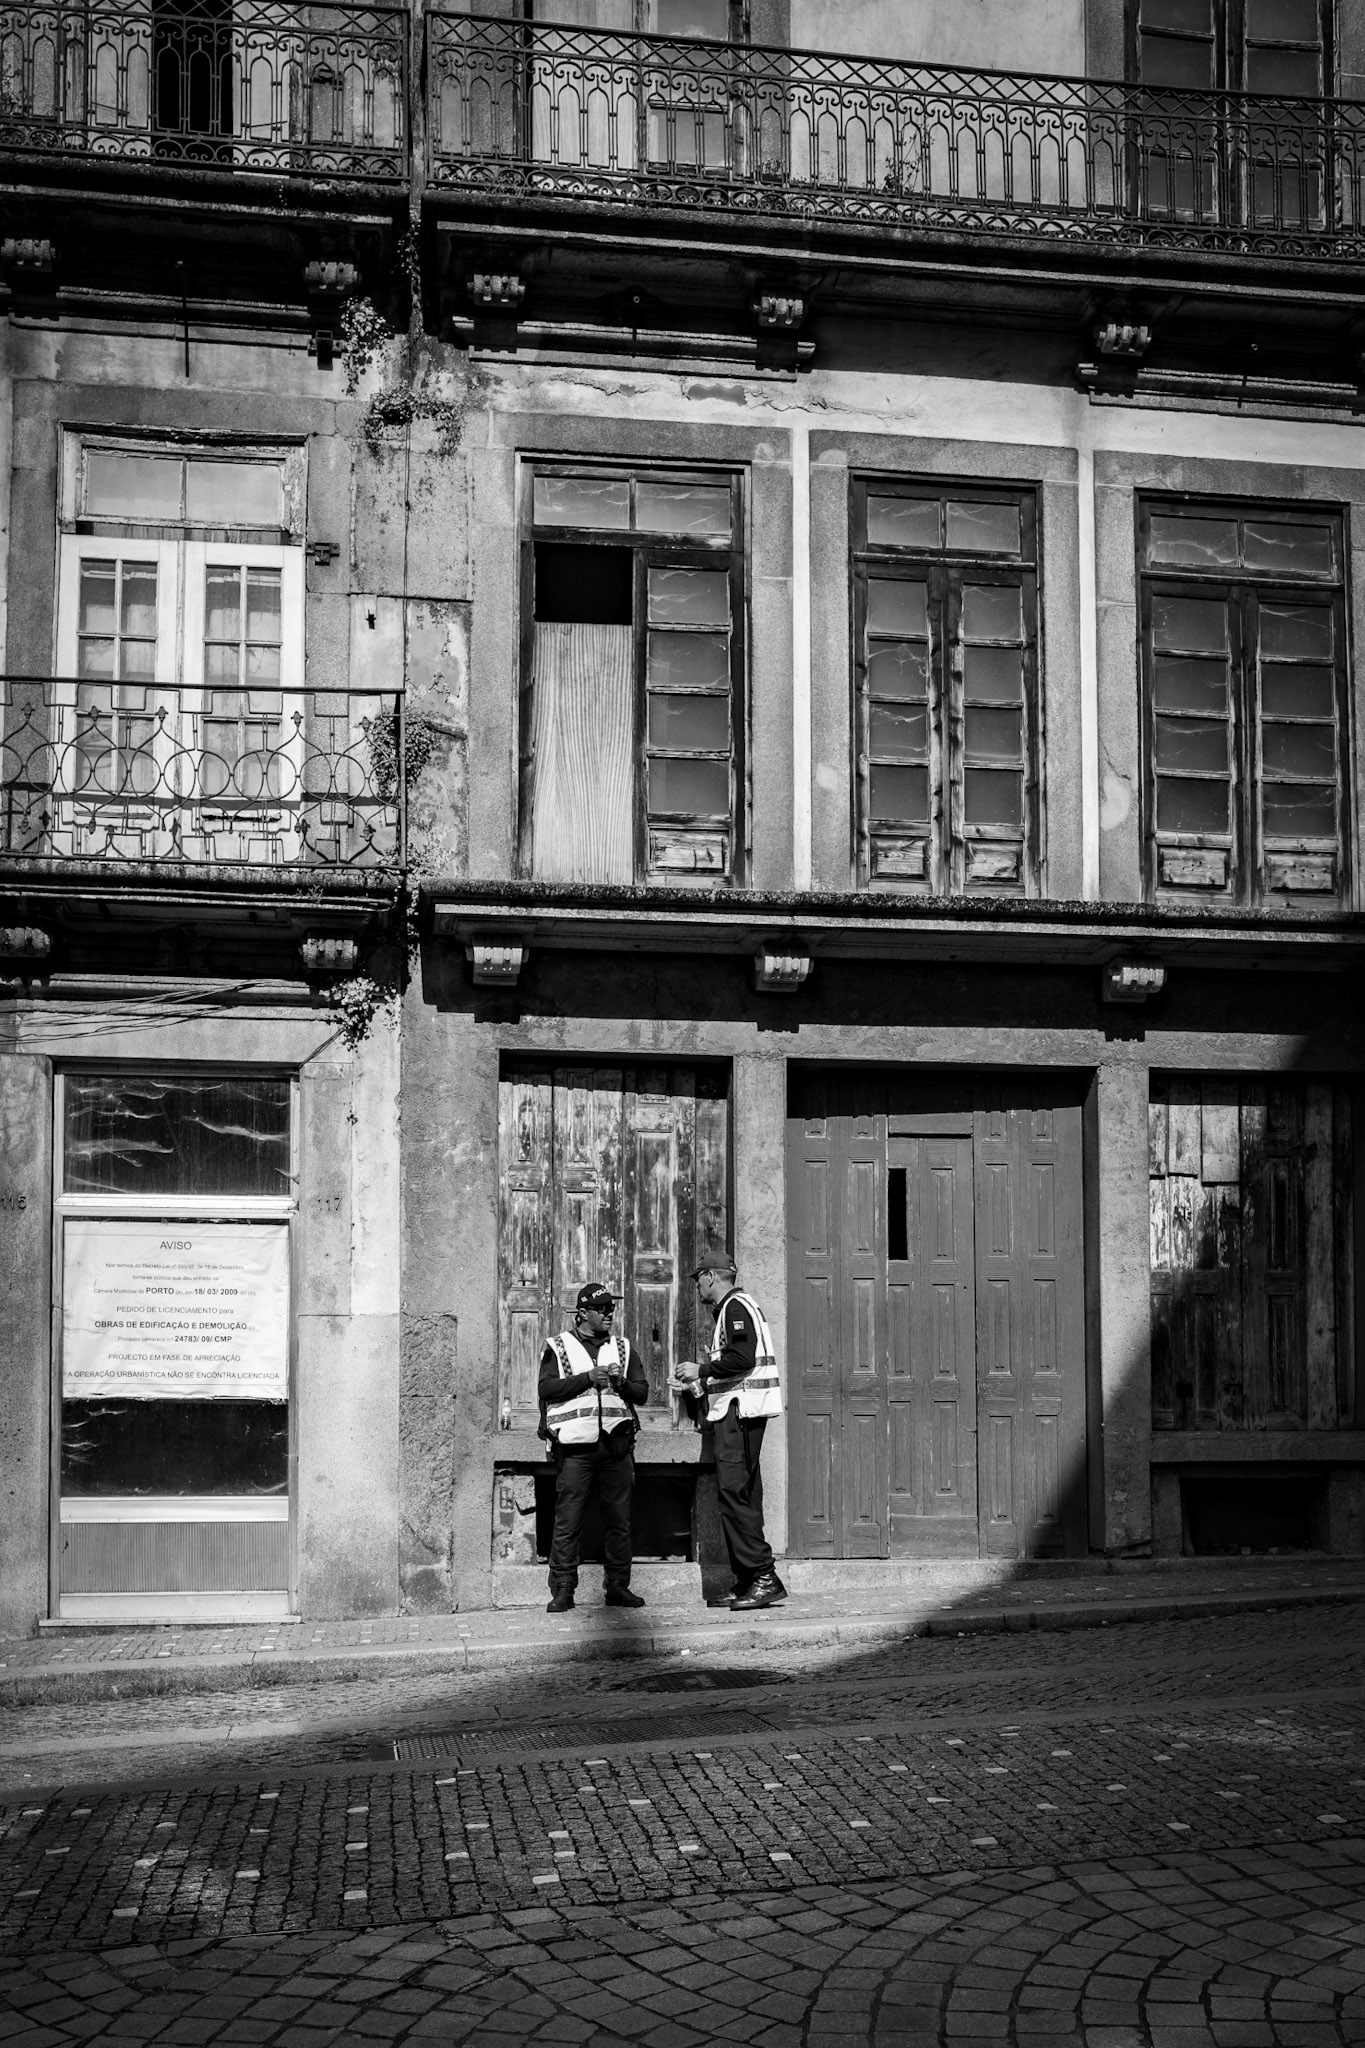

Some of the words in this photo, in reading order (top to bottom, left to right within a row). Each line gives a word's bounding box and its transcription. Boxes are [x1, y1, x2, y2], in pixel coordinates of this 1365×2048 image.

[2, 1195, 26, 1210] 115
[160, 1241, 192, 1250] AVISO
[207, 1288, 219, 1296] 03/
[158, 1306, 217, 1314] LICENCIAMENTO
[139, 1321, 190, 1330] EDIFICAÇÃO
[199, 1320, 247, 1331] DEMOLIÇÃO
[174, 1335, 199, 1343] 24783/
[201, 1335, 213, 1343] 09/
[108, 1353, 148, 1361] PROJECTO
[194, 1353, 241, 1362] APRECIAÇÃO
[74, 1370, 115, 1378] OPERAÇÃO
[116, 1370, 166, 1378] URBANÍSTICA
[196, 1371, 236, 1379] ENCONTRA
